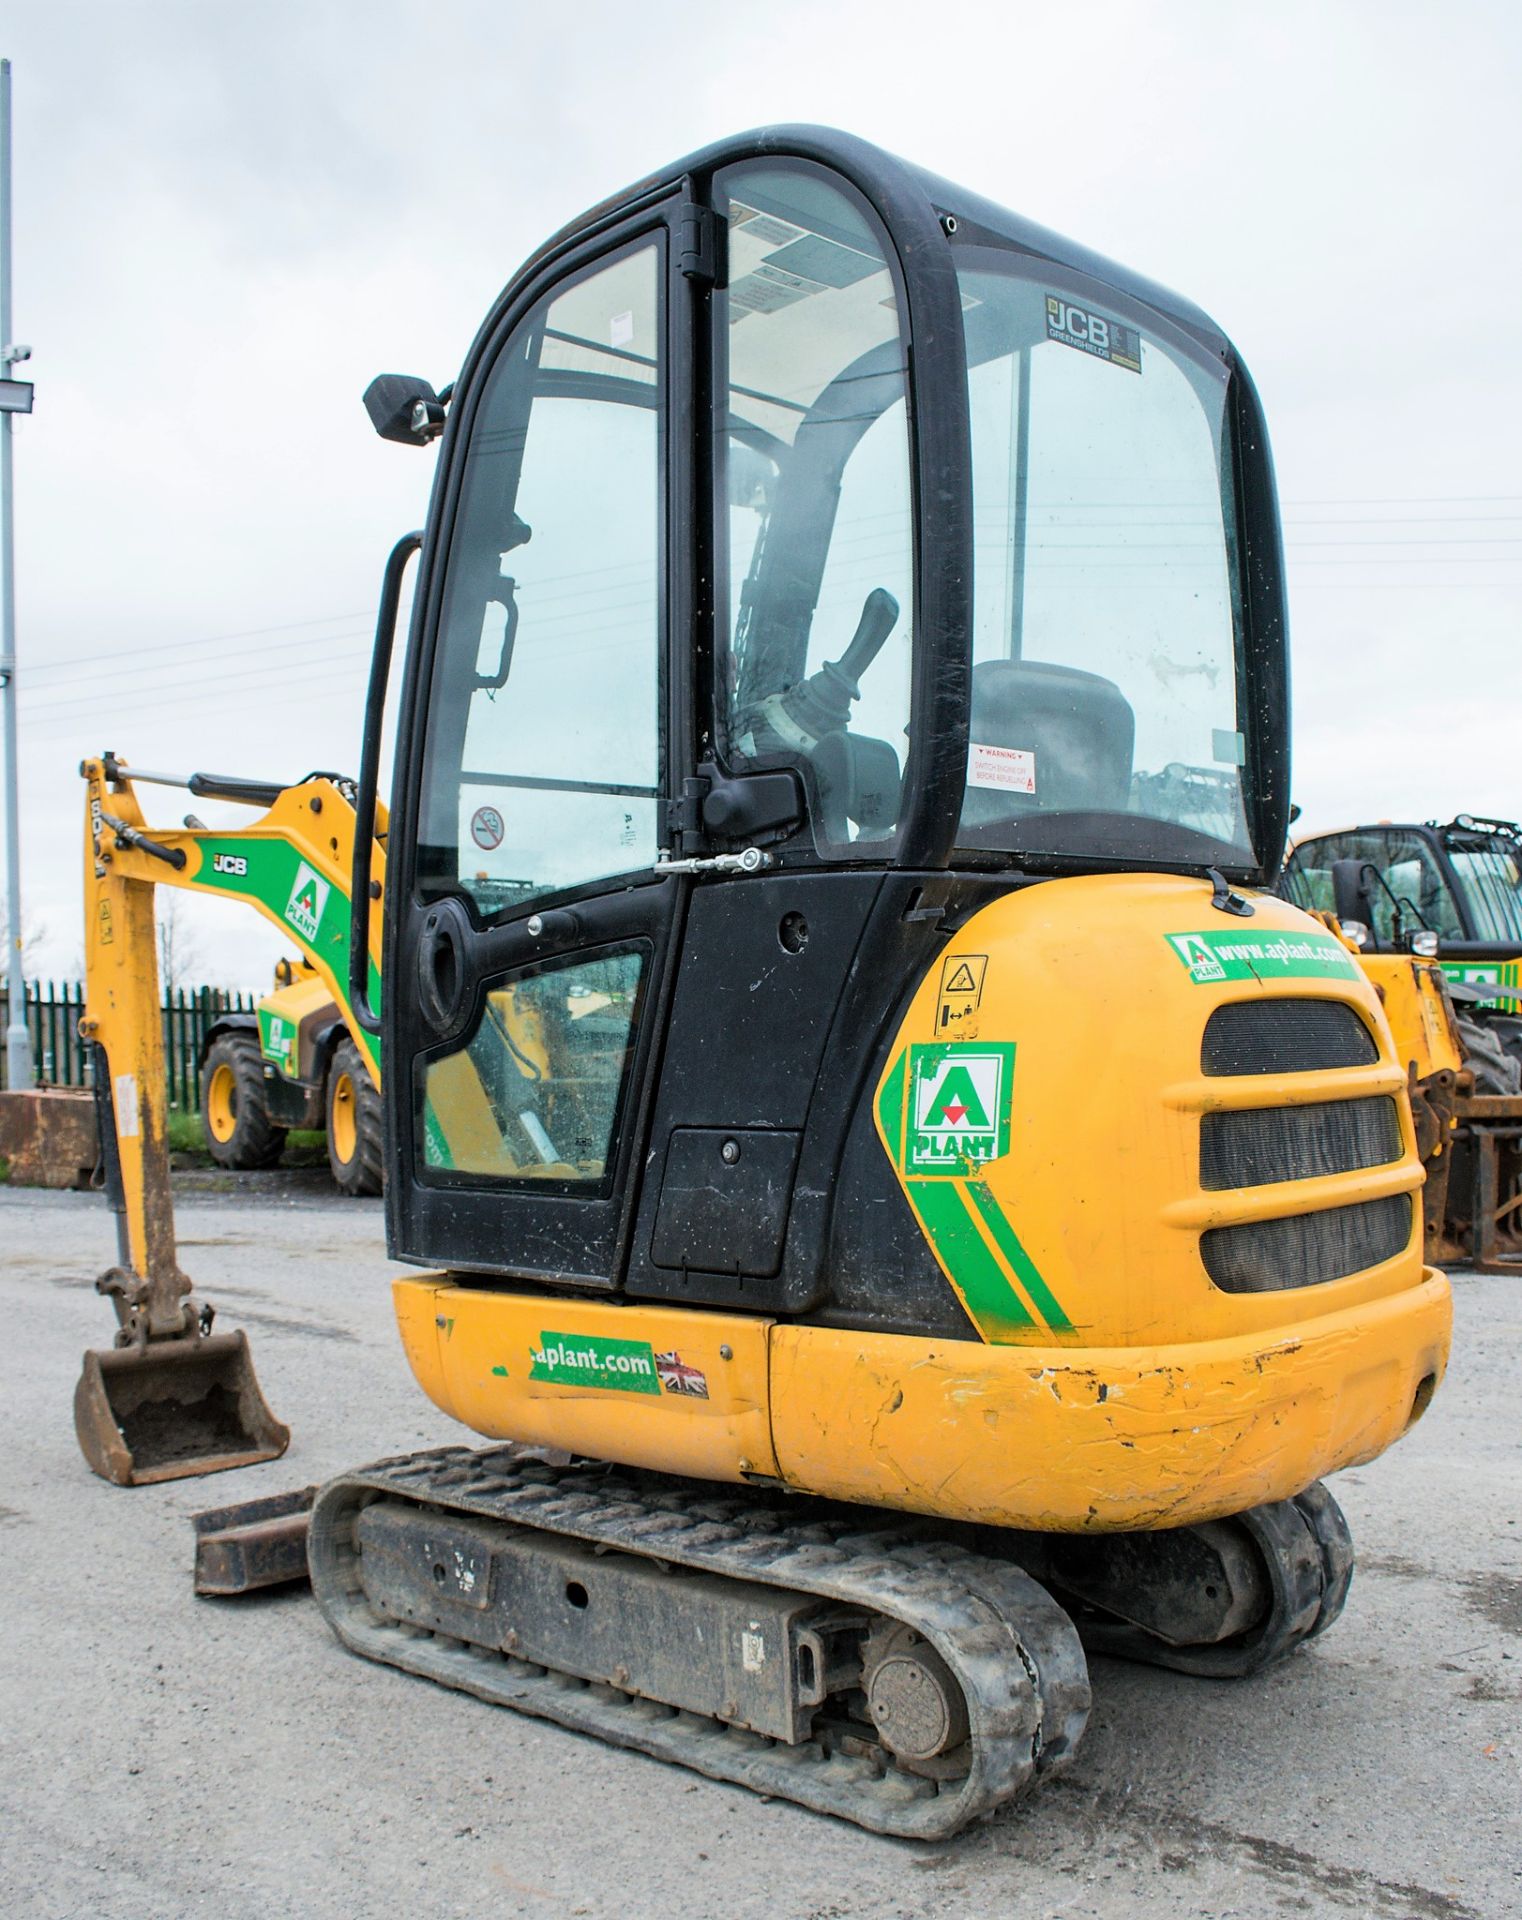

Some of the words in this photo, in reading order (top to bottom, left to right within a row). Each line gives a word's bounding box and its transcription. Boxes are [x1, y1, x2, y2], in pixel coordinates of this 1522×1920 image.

[1048, 303, 1109, 348] JCB
[986, 748, 1017, 759] WARNING
[213, 854, 247, 875] JCB
[294, 878, 317, 920] A
[287, 903, 316, 936] PLANT
[1186, 939, 1217, 964] A
[1213, 939, 1349, 965] www.aplant.com
[1193, 965, 1225, 977] PLANT
[923, 1066, 991, 1126] A
[916, 1135, 996, 1157] PLANT
